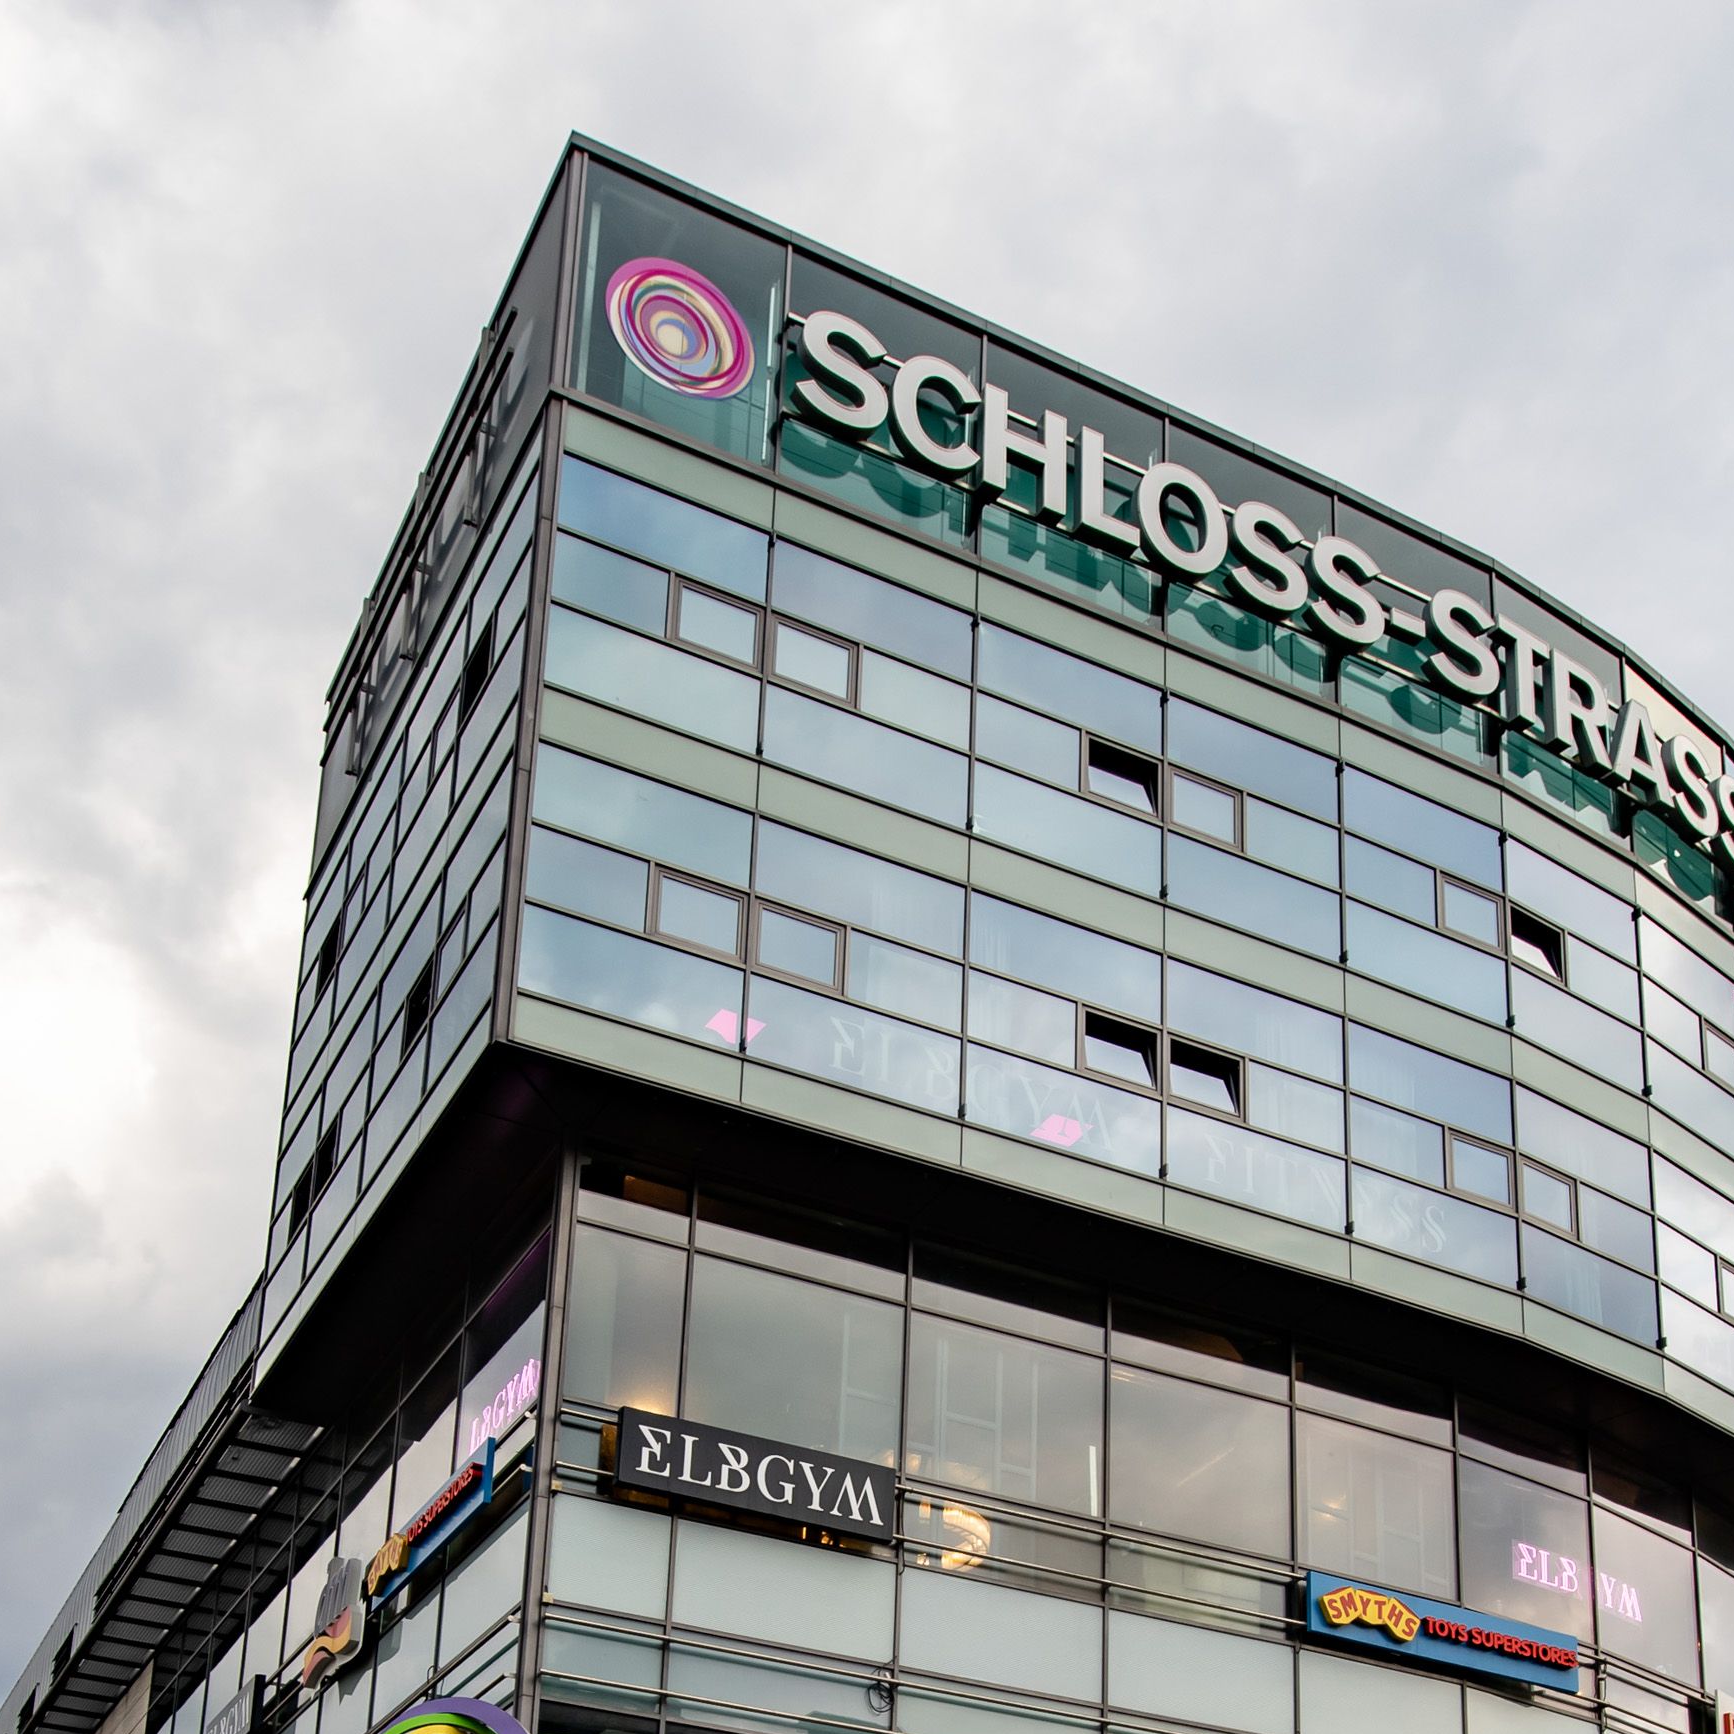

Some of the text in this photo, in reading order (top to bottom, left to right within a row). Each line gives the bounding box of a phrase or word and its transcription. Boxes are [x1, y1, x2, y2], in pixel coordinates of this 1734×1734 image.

[468, 1358, 536, 1456] LBGYM
[635, 1424, 885, 1528] ELBGYM
[1517, 1543, 1643, 1622] ELBYM
[1327, 1594, 1578, 1668] SMYTHS TOYS SUPERSTORES
